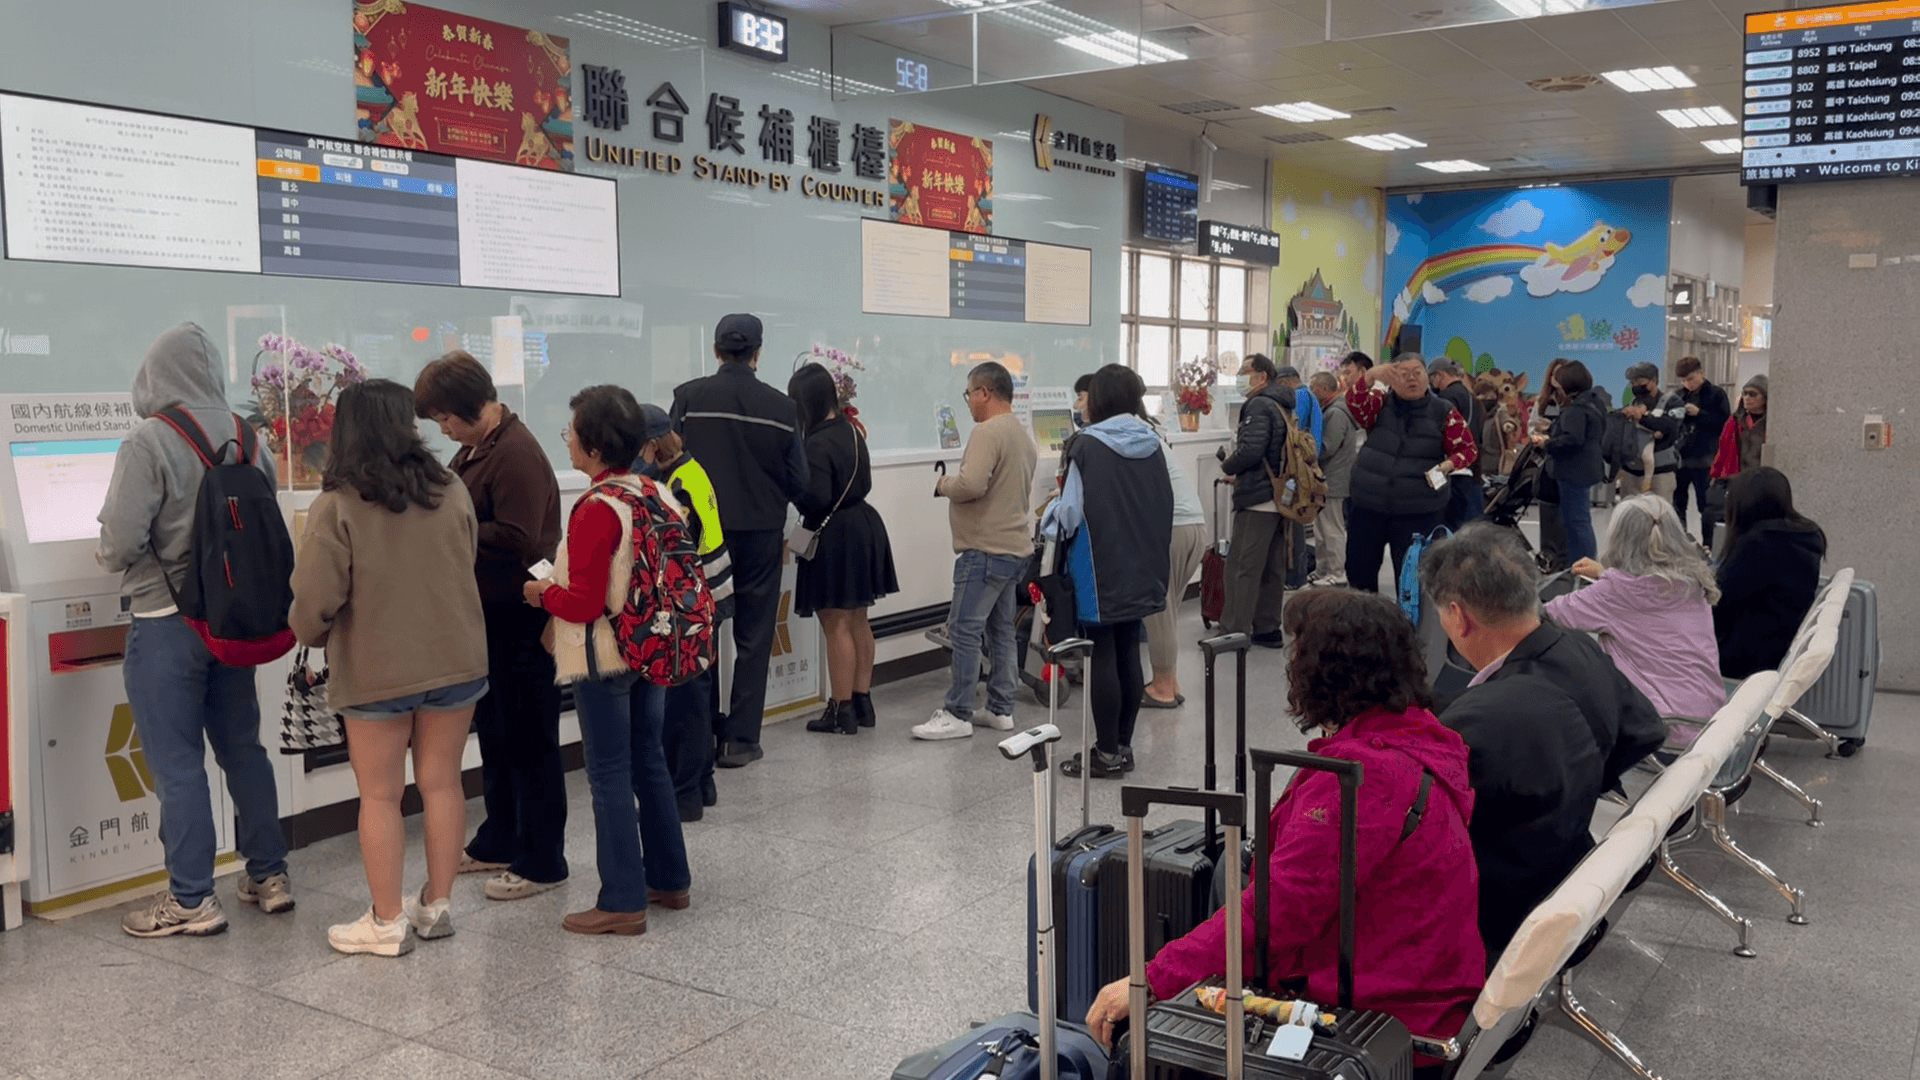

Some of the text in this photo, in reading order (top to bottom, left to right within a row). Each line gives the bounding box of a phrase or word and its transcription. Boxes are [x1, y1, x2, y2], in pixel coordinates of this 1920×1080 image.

[442, 24, 494, 51] 恭賀新春
[742, 12, 784, 55] 8:32
[1797, 48, 1820, 58] 8952
[1850, 42, 1892, 54] Taichung
[1797, 65, 1820, 76] 8802
[1850, 60, 1878, 72] Taipei
[424, 66, 514, 112] 新年快樂
[1796, 82, 1814, 92] 302
[1826, 80, 1846, 90] 高雄
[1848, 76, 1898, 88] Kaohsiung
[1796, 100, 1813, 110] 762
[1848, 94, 1890, 106] Taichung
[582, 64, 886, 180] 聯合候補櫃檯
[1795, 116, 1818, 126] 8912
[1824, 114, 1844, 124] 高雄
[1846, 111, 1896, 122] Kaohsiung
[1795, 133, 1812, 143] 306
[1824, 130, 1844, 141] 高雄
[1846, 128, 1895, 140] Kaohsiung
[275, 148, 302, 160] 公司別
[307, 138, 352, 154] 金門航空站
[585, 136, 885, 208] UNIFIED STAND-BY COUNTER
[1746, 159, 1920, 180] 旅途愉快 Welcome to Ki
[922, 168, 964, 195] 新年快樂
[14, 422, 63, 434] Domestic
[65, 421, 101, 432] Unified
[70, 843, 130, 864] KINMEN
